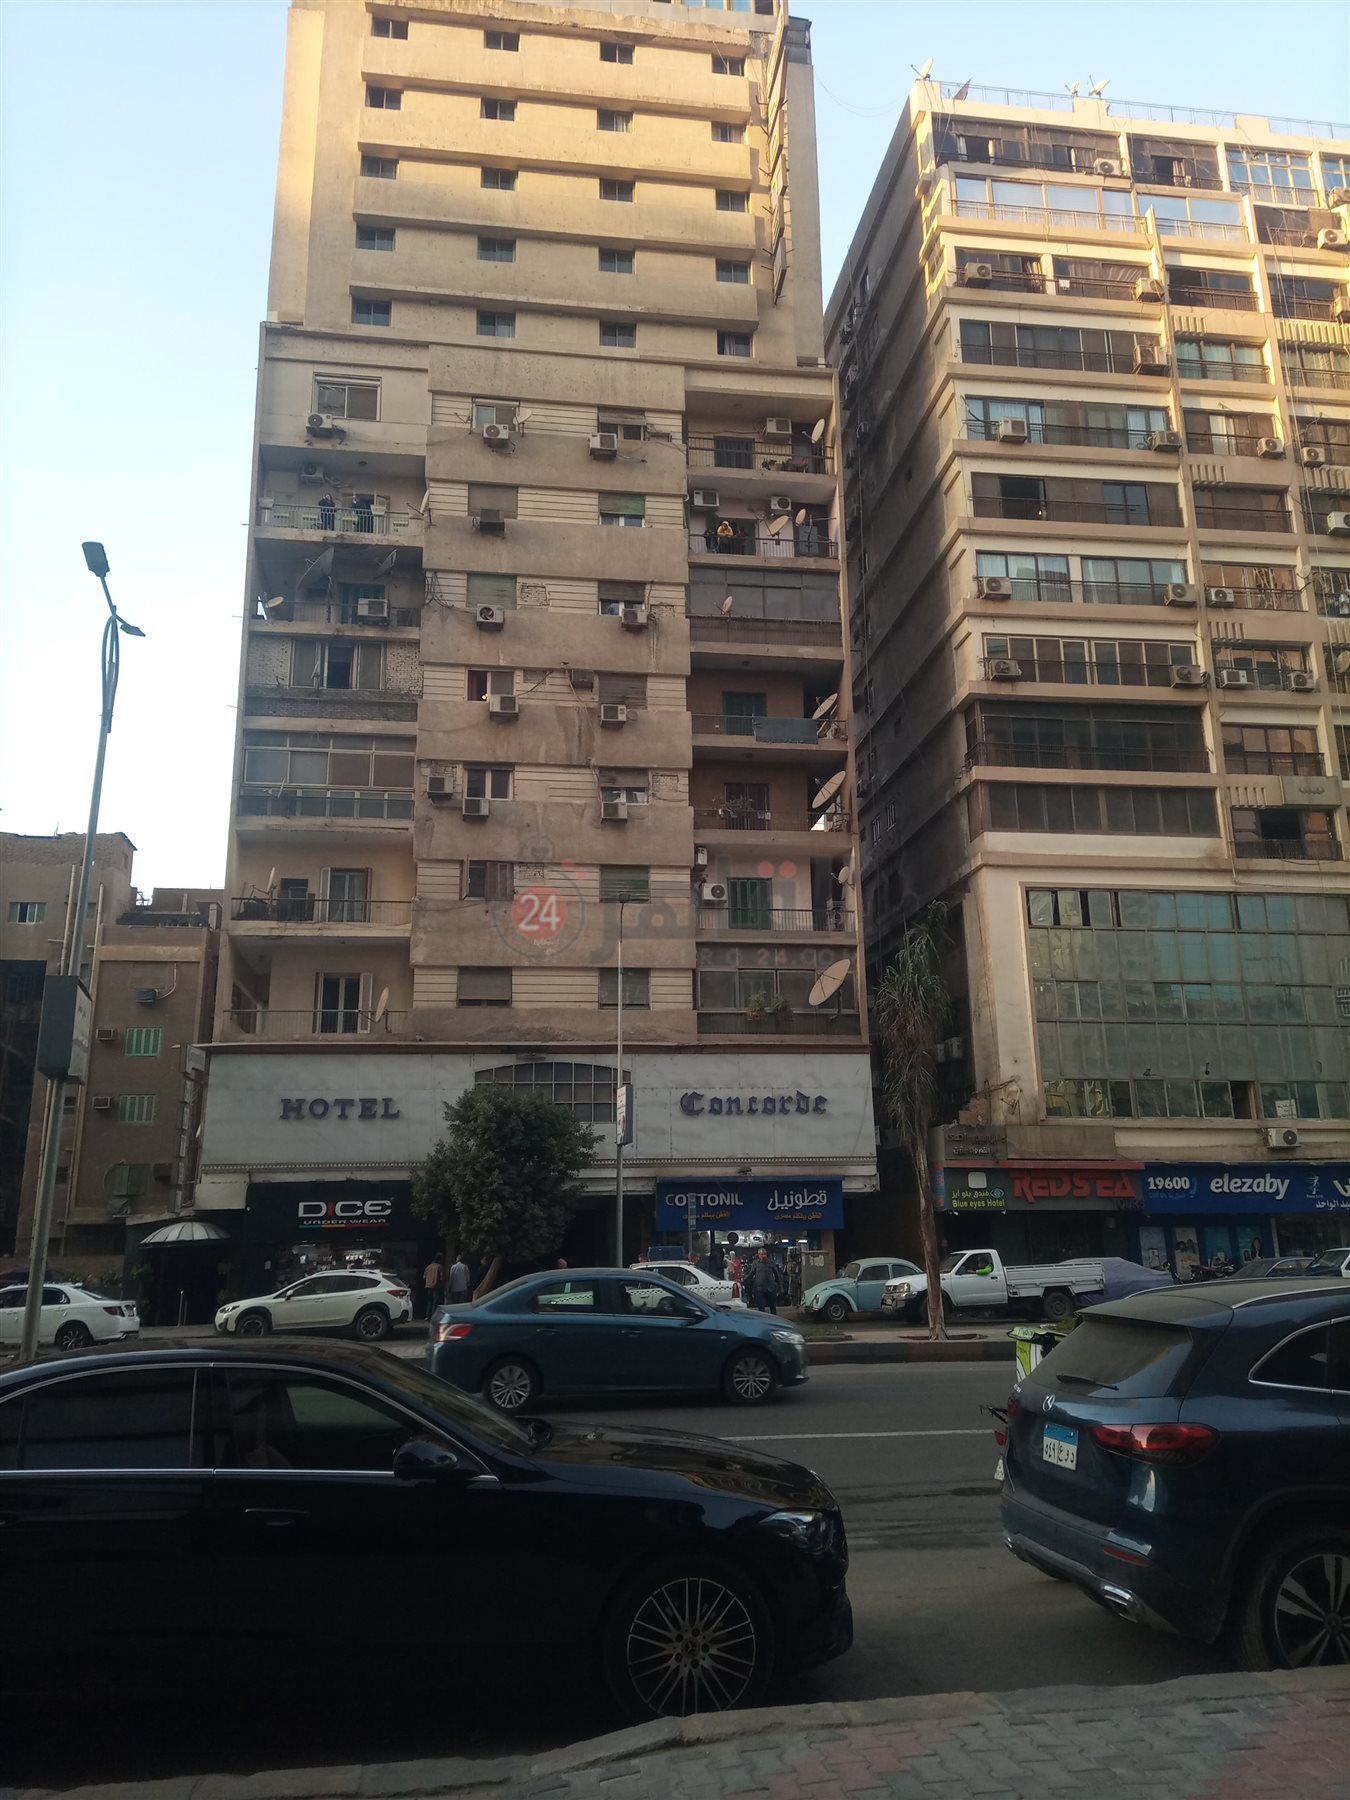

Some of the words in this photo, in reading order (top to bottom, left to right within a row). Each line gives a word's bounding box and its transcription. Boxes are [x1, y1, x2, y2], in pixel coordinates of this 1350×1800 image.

[280, 1097, 401, 1121] HOTEL
[680, 1090, 828, 1117] Concorde
[1147, 1176, 1190, 1190] 19600
[1210, 1172, 1290, 1200] elezaby
[297, 1200, 392, 1217] DICE
[665, 1192, 744, 1206] COTONIL
[767, 1188, 828, 1211] قطونيل
[952, 1199, 968, 1208] Blue
[969, 1200, 985, 1209] eyes
[987, 1198, 1005, 1207] Hotel
